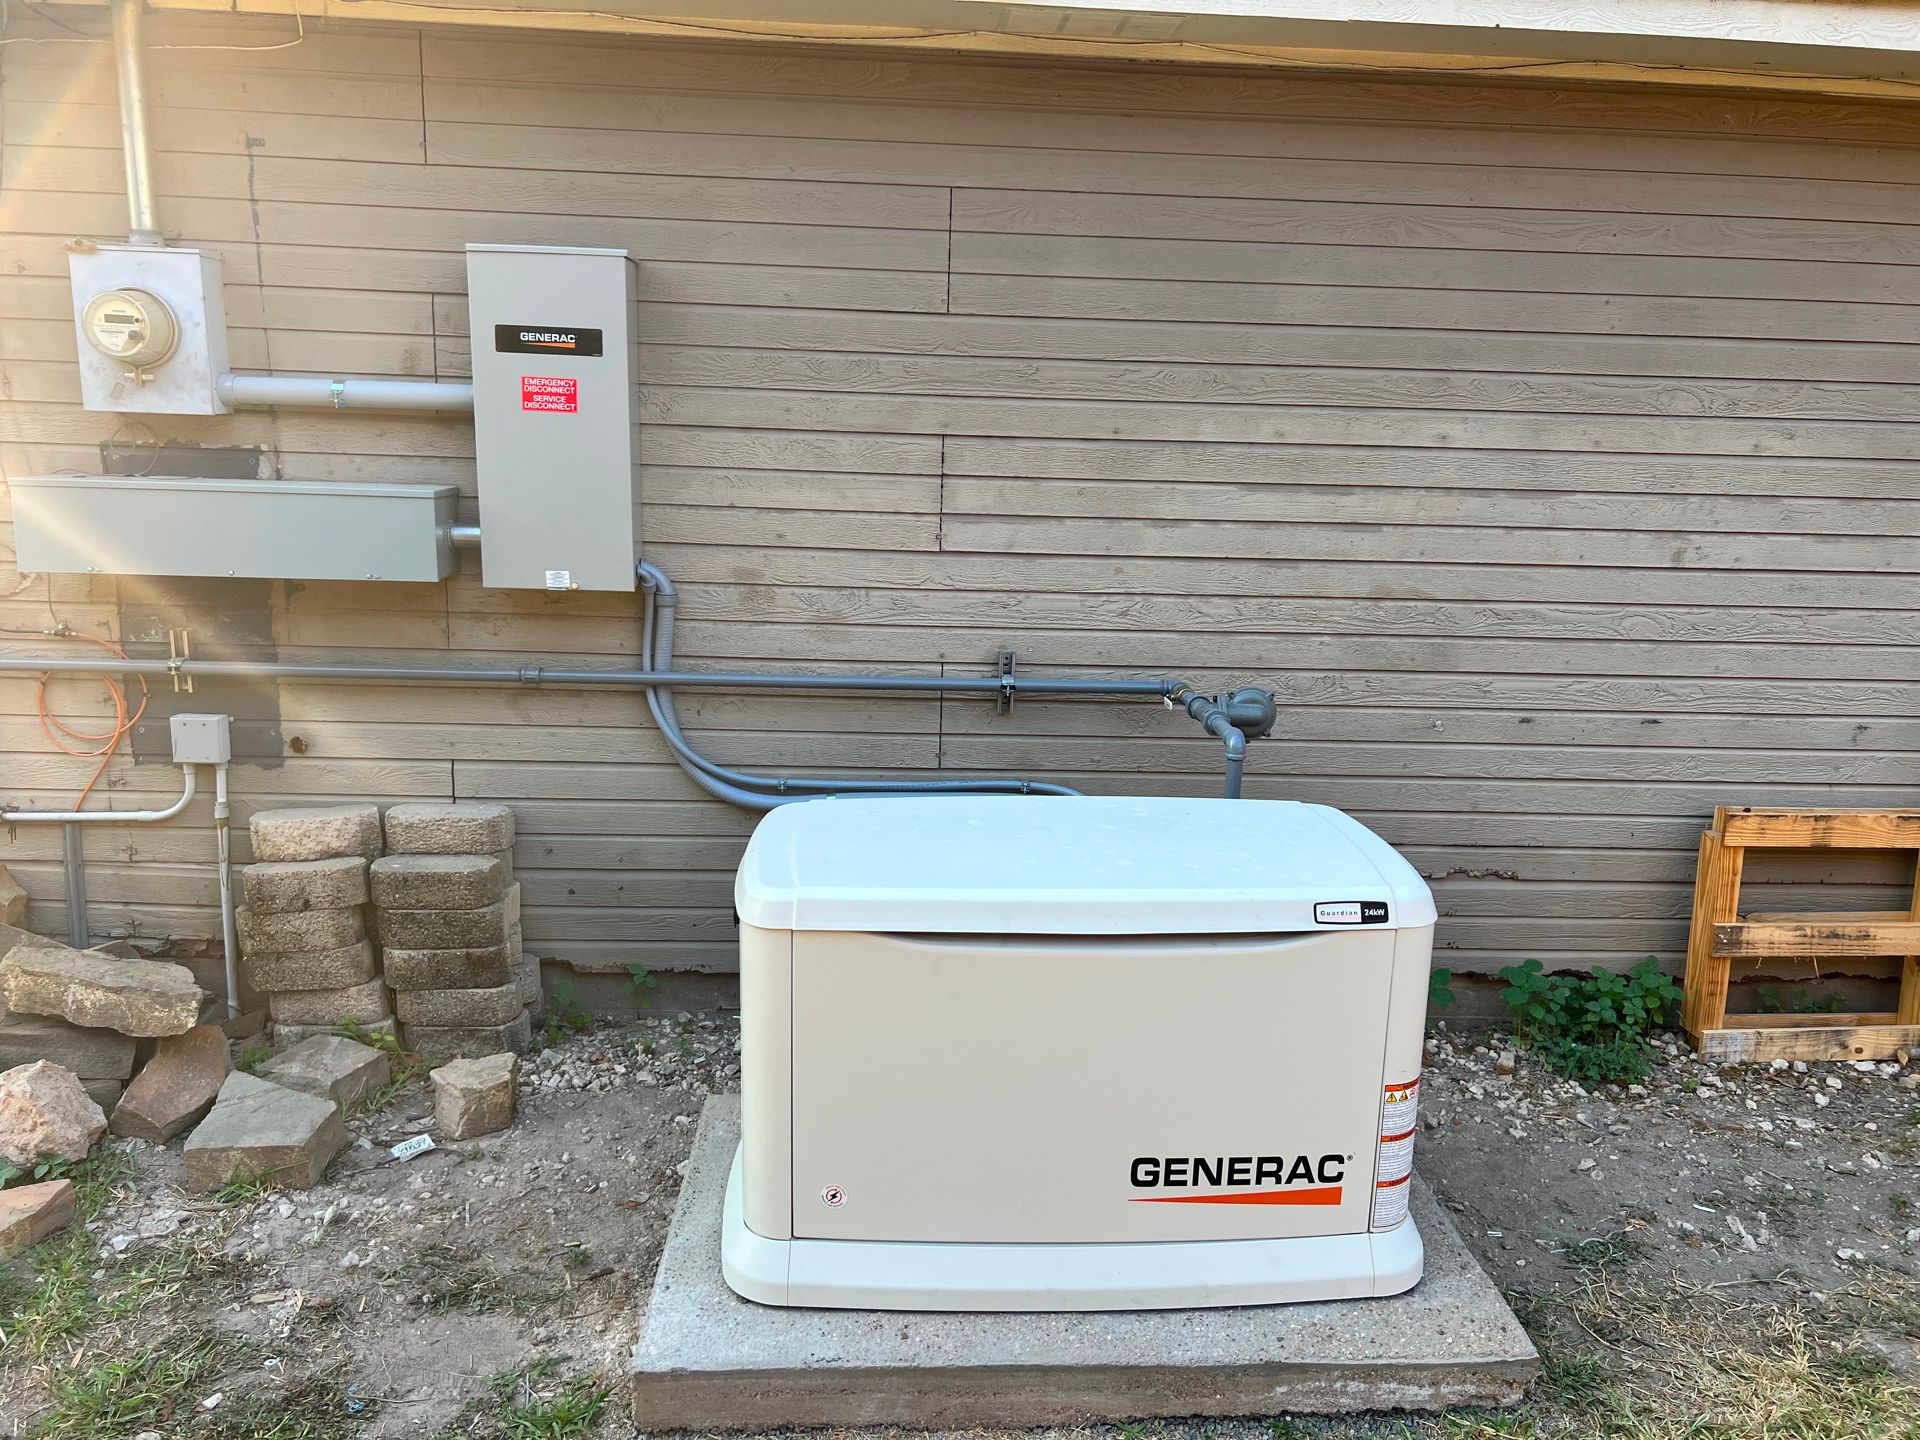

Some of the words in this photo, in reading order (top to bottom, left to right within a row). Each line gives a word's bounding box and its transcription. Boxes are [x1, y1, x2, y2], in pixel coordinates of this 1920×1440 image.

[520, 332, 576, 343] GENERAC
[524, 378, 574, 387] EMERGENCY
[524, 385, 575, 394] DISCONNECT
[533, 395, 567, 403] SERVICE
[524, 401, 575, 411] DISCONNECT
[1364, 908, 1385, 916] 24kW
[1130, 1154, 1345, 1187] GENERAC
